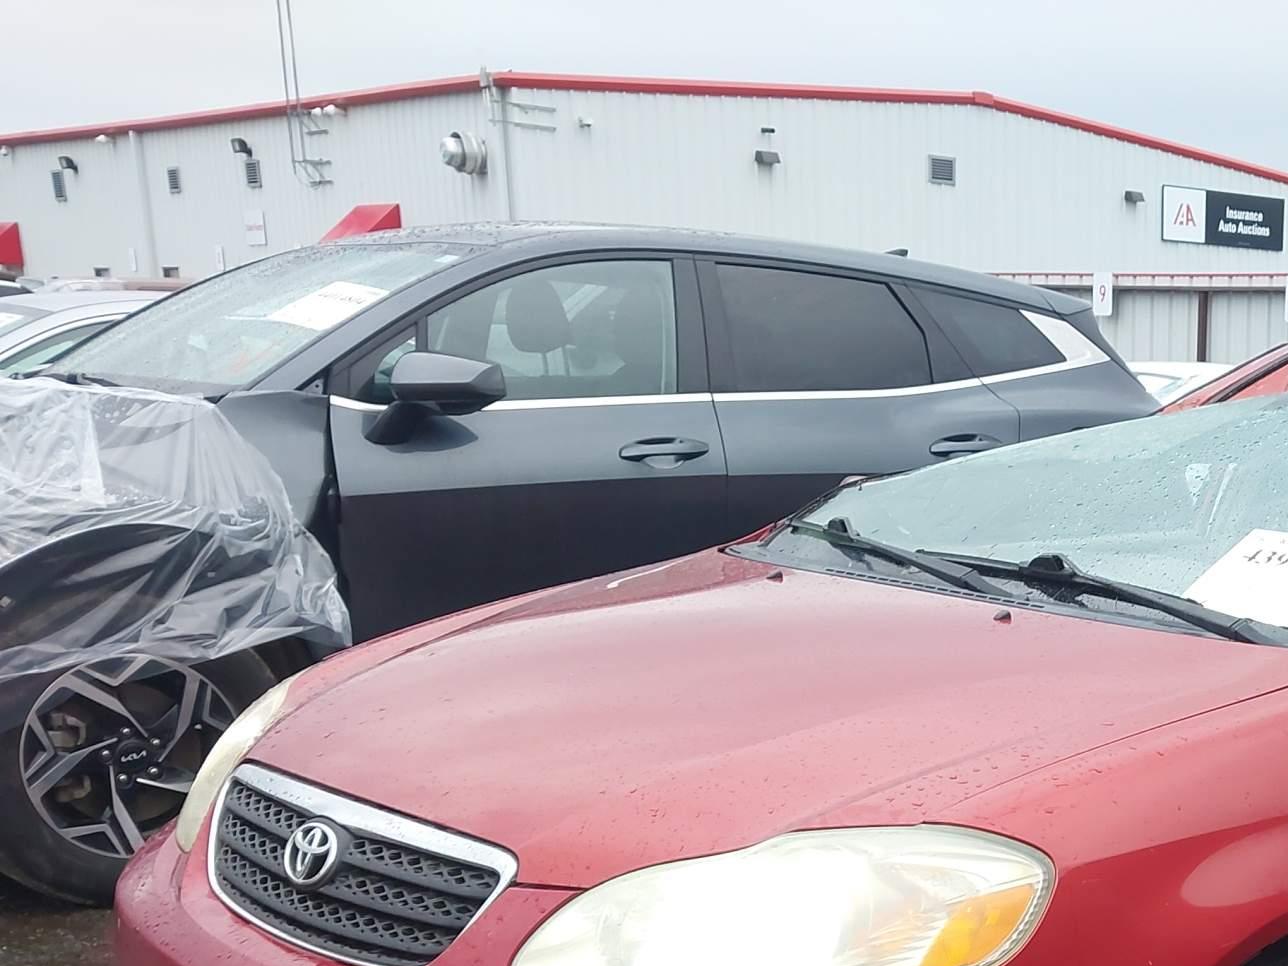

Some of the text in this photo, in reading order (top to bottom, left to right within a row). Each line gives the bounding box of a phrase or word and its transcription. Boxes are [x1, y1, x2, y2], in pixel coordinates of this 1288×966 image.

[1225, 206, 1264, 222] Insurance
[1218, 219, 1271, 237] Auto Auctions
[1099, 284, 1106, 303] 9
